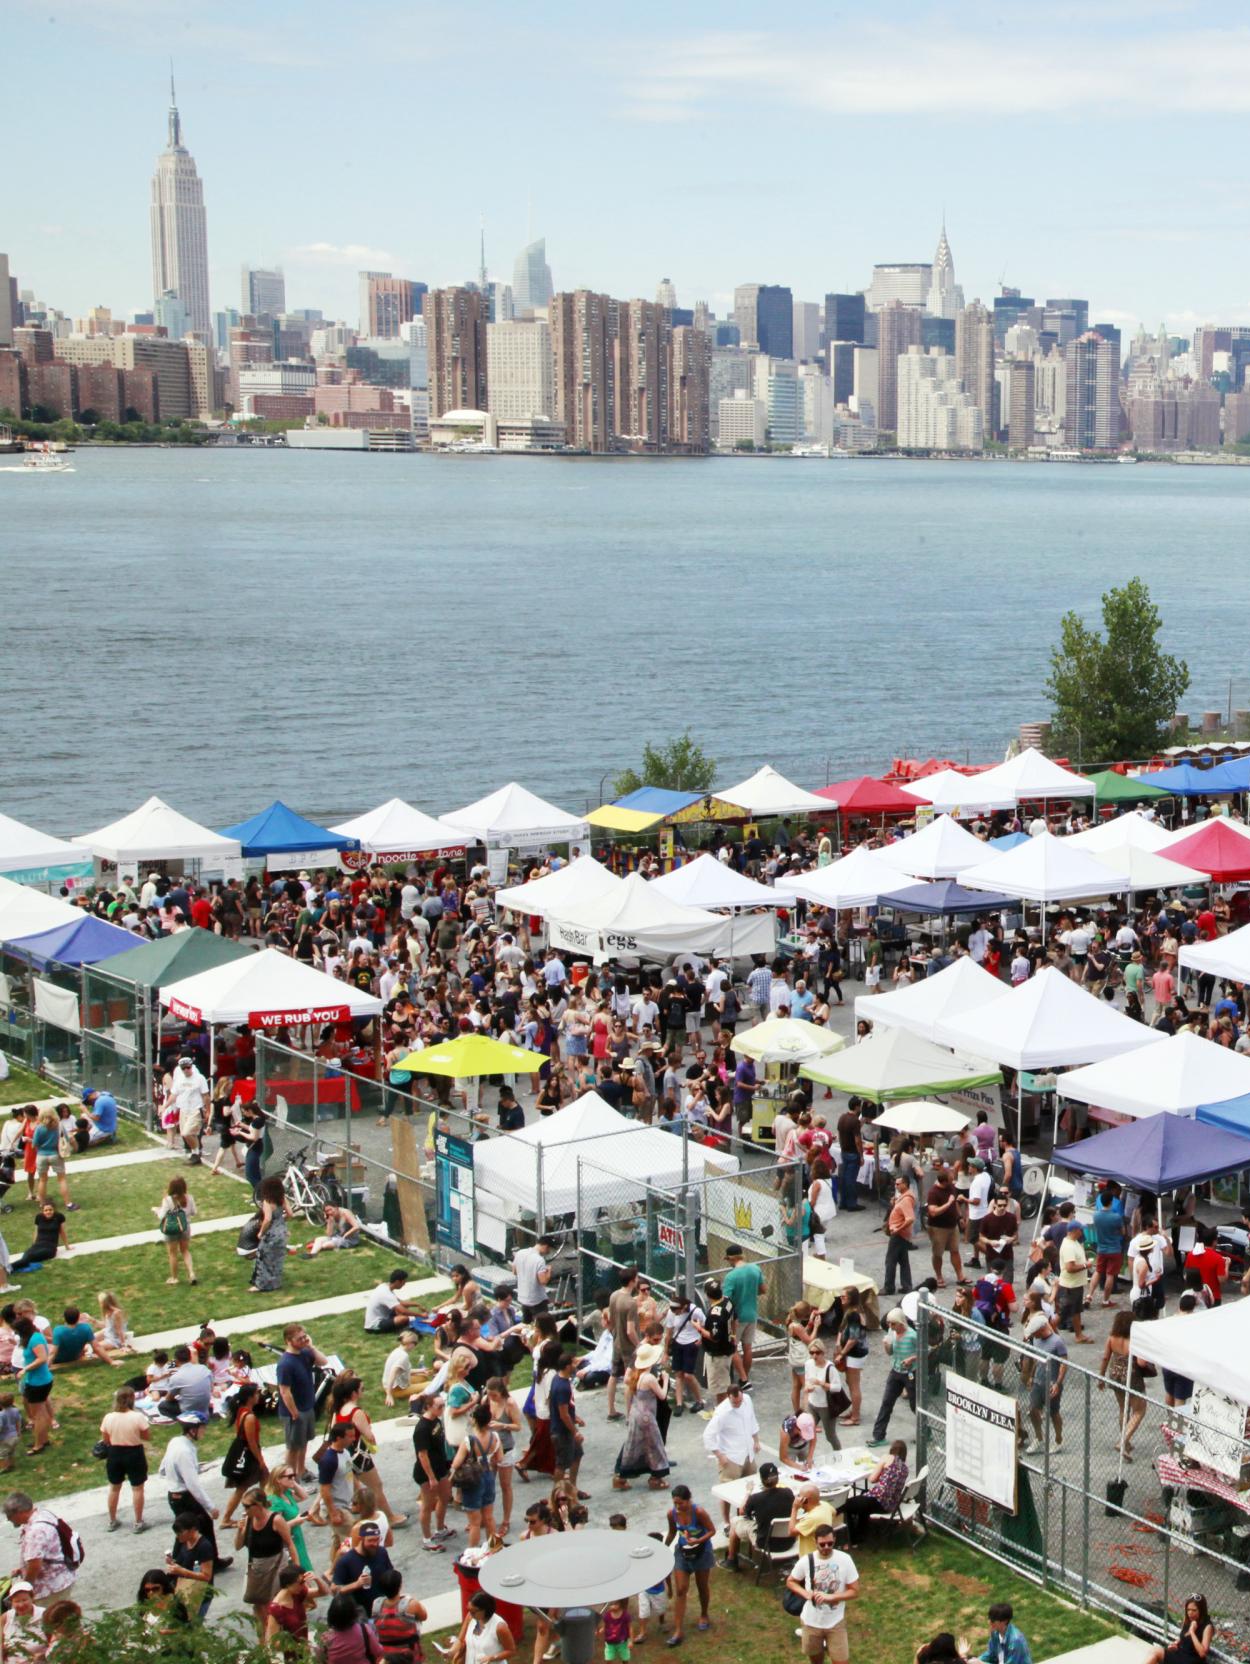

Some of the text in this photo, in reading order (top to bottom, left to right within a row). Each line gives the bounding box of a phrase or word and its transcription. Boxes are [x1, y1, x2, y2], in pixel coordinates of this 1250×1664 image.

[378, 851, 418, 865] noodle
[606, 933, 638, 950] egg
[261, 1010, 340, 1026] WE RUB YOU
[947, 1391, 989, 1419] BROOKLYN
